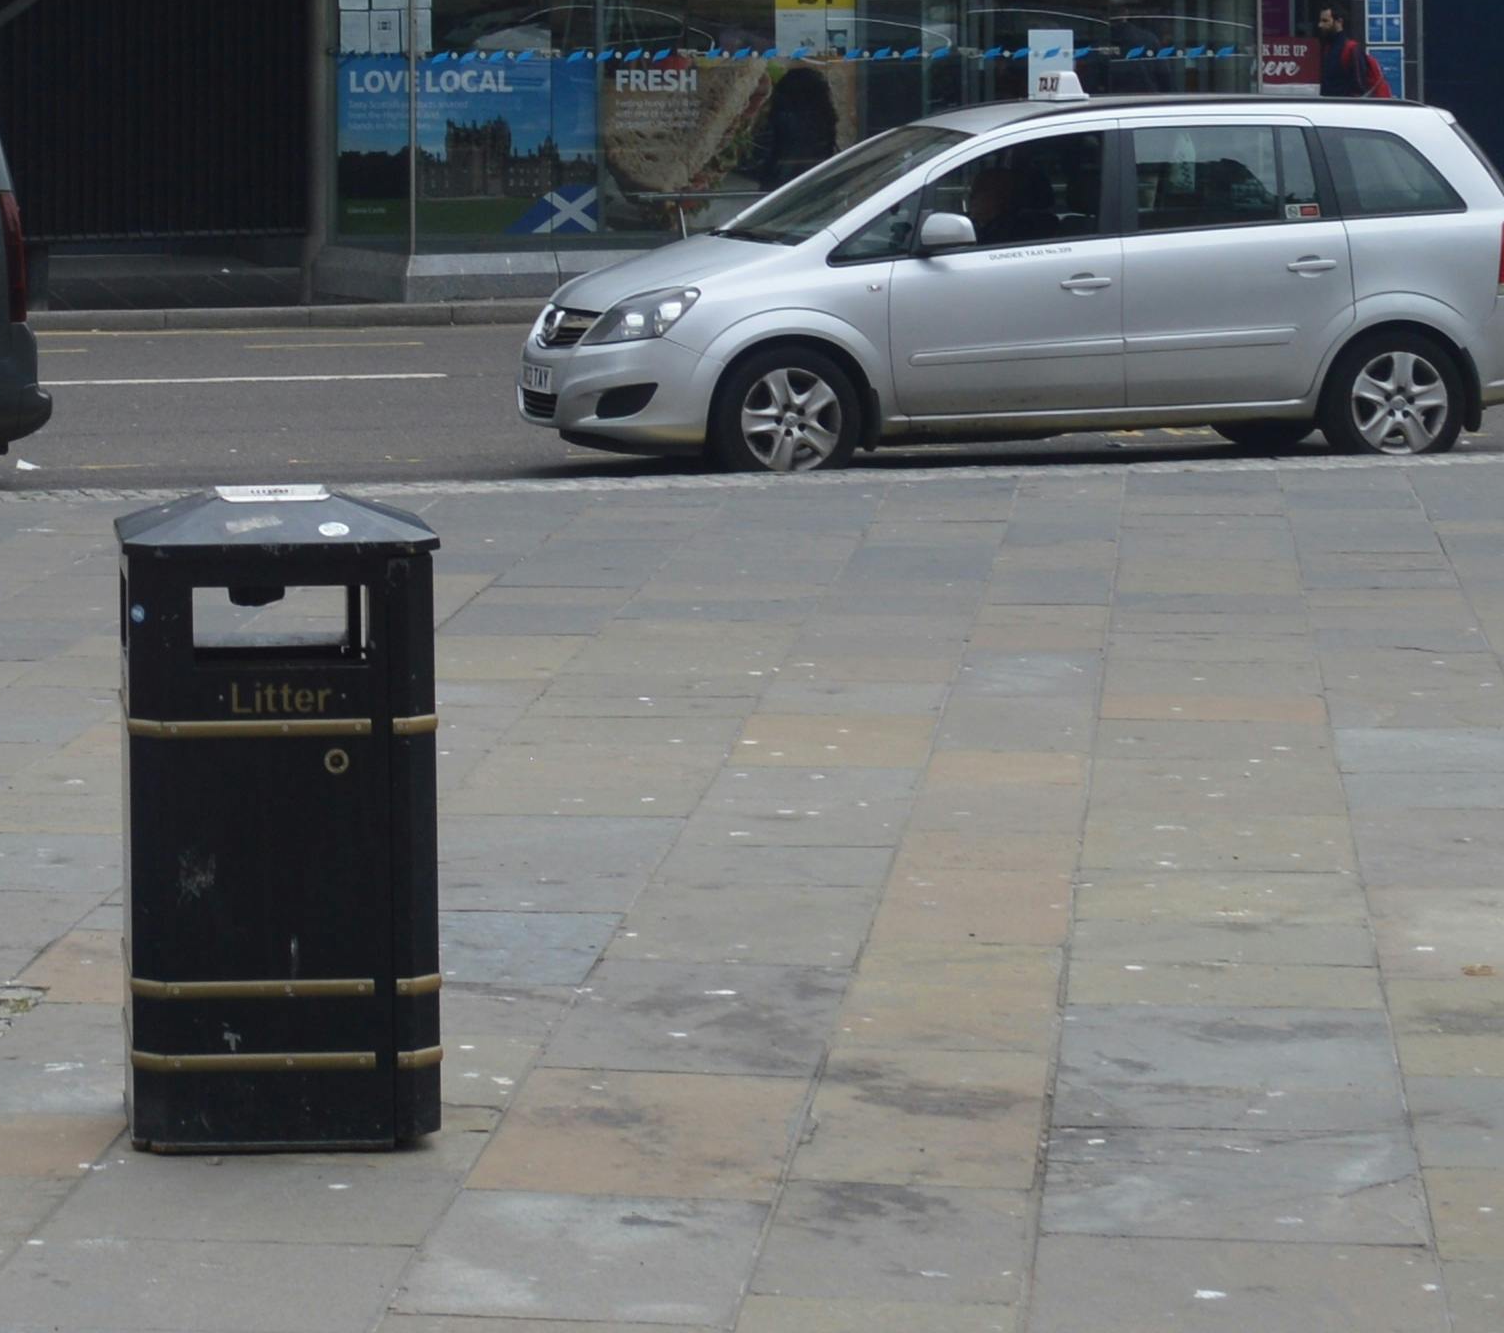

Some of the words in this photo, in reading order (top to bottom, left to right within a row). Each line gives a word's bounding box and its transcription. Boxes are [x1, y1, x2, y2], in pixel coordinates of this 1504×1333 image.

[1273, 45, 1290, 56] ME
[1294, 45, 1308, 56] UP
[349, 70, 420, 93] LOVE
[426, 70, 513, 93] LOCAL
[616, 69, 697, 93] FRESH
[229, 682, 332, 714] Litter
